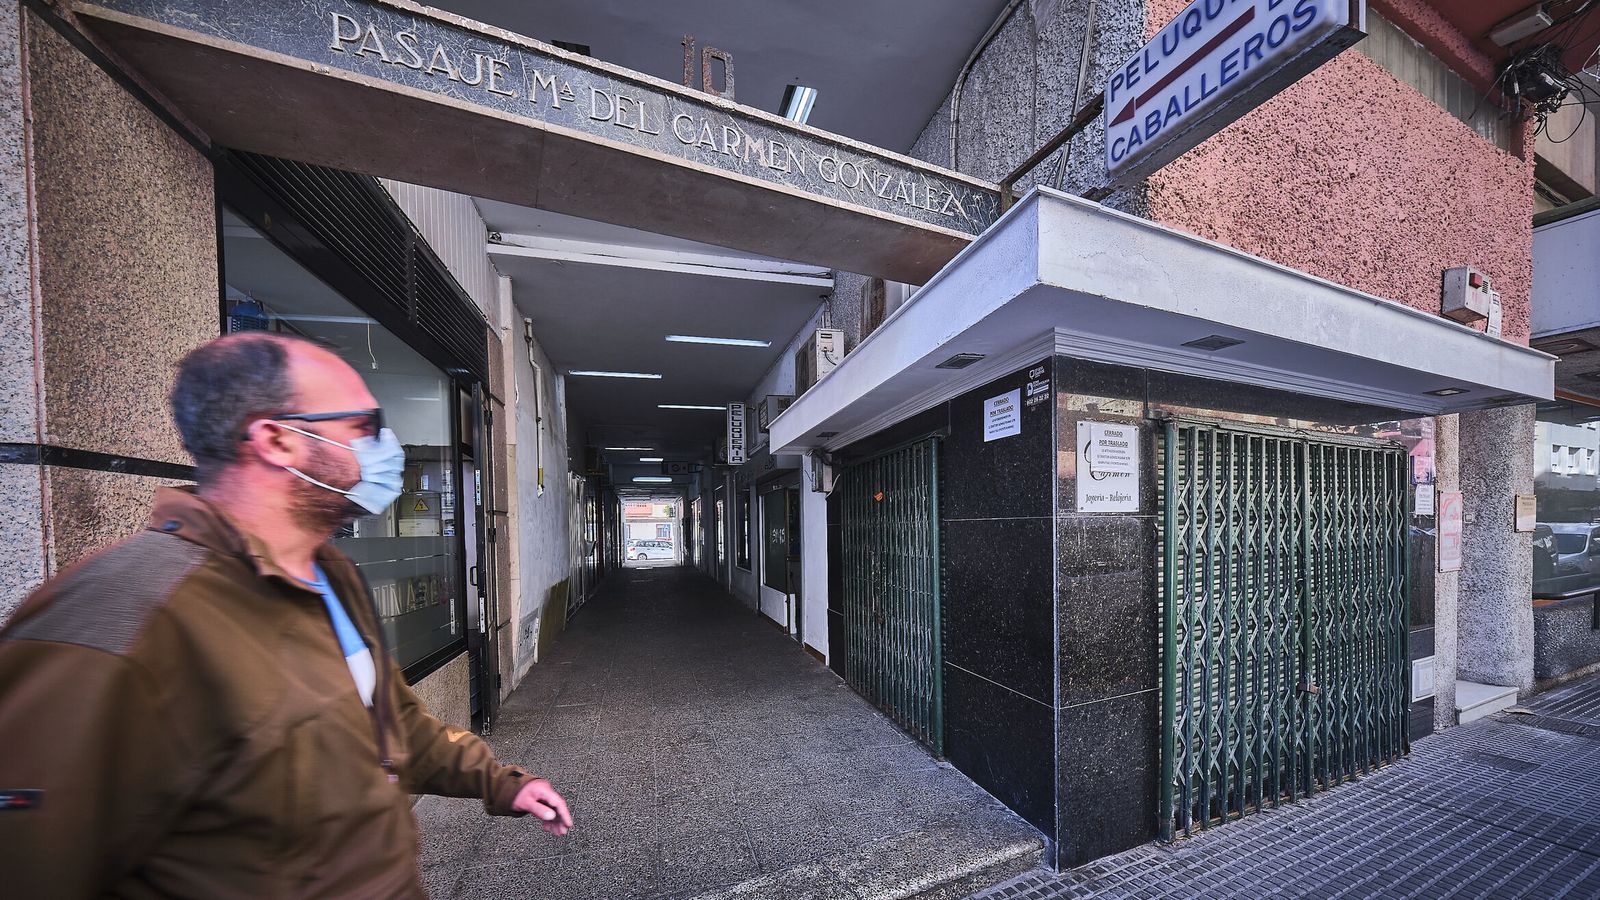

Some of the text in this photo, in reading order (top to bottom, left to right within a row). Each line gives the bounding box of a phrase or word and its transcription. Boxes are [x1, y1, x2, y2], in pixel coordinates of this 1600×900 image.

[328, 11, 516, 97] PASAJE
[589, 86, 659, 135] DEL
[671, 114, 805, 176] CARMEN
[818, 156, 957, 217] GONZALEZ
[1110, 0, 1238, 102] PELUQU
[1111, 0, 1317, 163] CABALLEROS
[731, 404, 743, 462] PELUQUERIA
